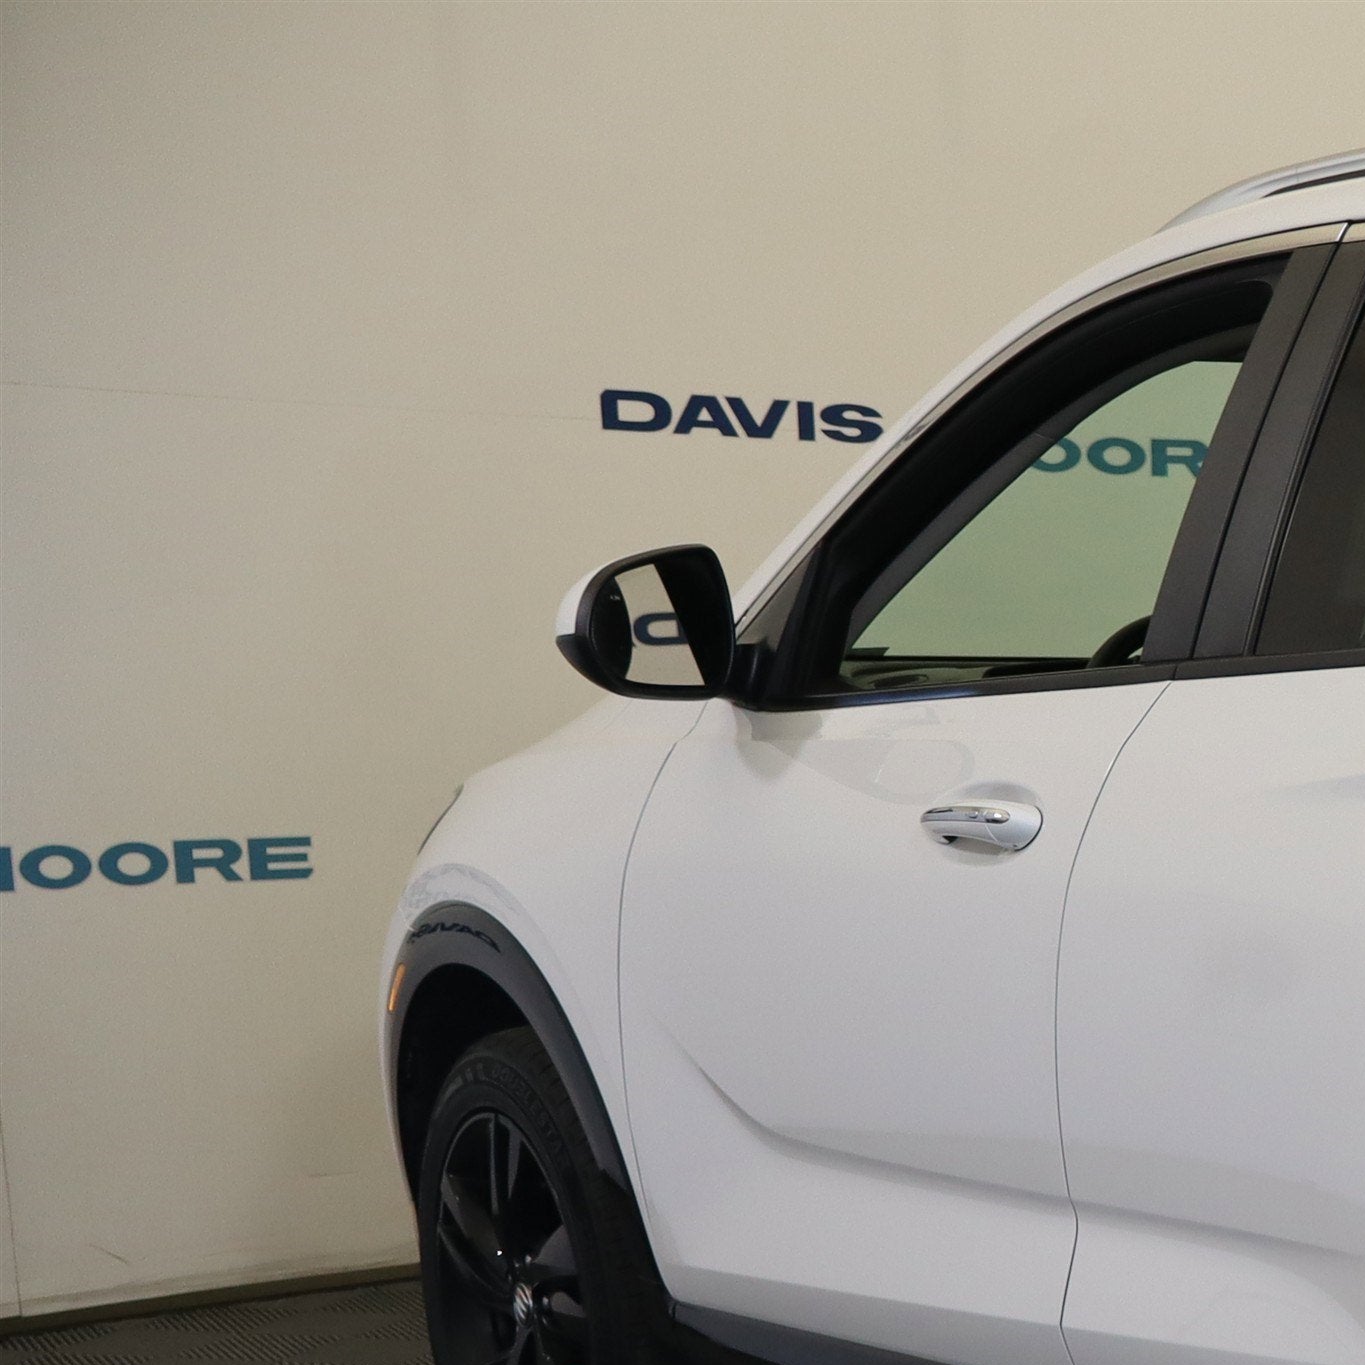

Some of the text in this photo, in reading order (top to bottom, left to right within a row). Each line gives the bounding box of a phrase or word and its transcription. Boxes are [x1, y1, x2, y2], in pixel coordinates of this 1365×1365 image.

[599, 388, 1209, 477] DAVIS OOR
[0, 836, 314, 892] OORE
